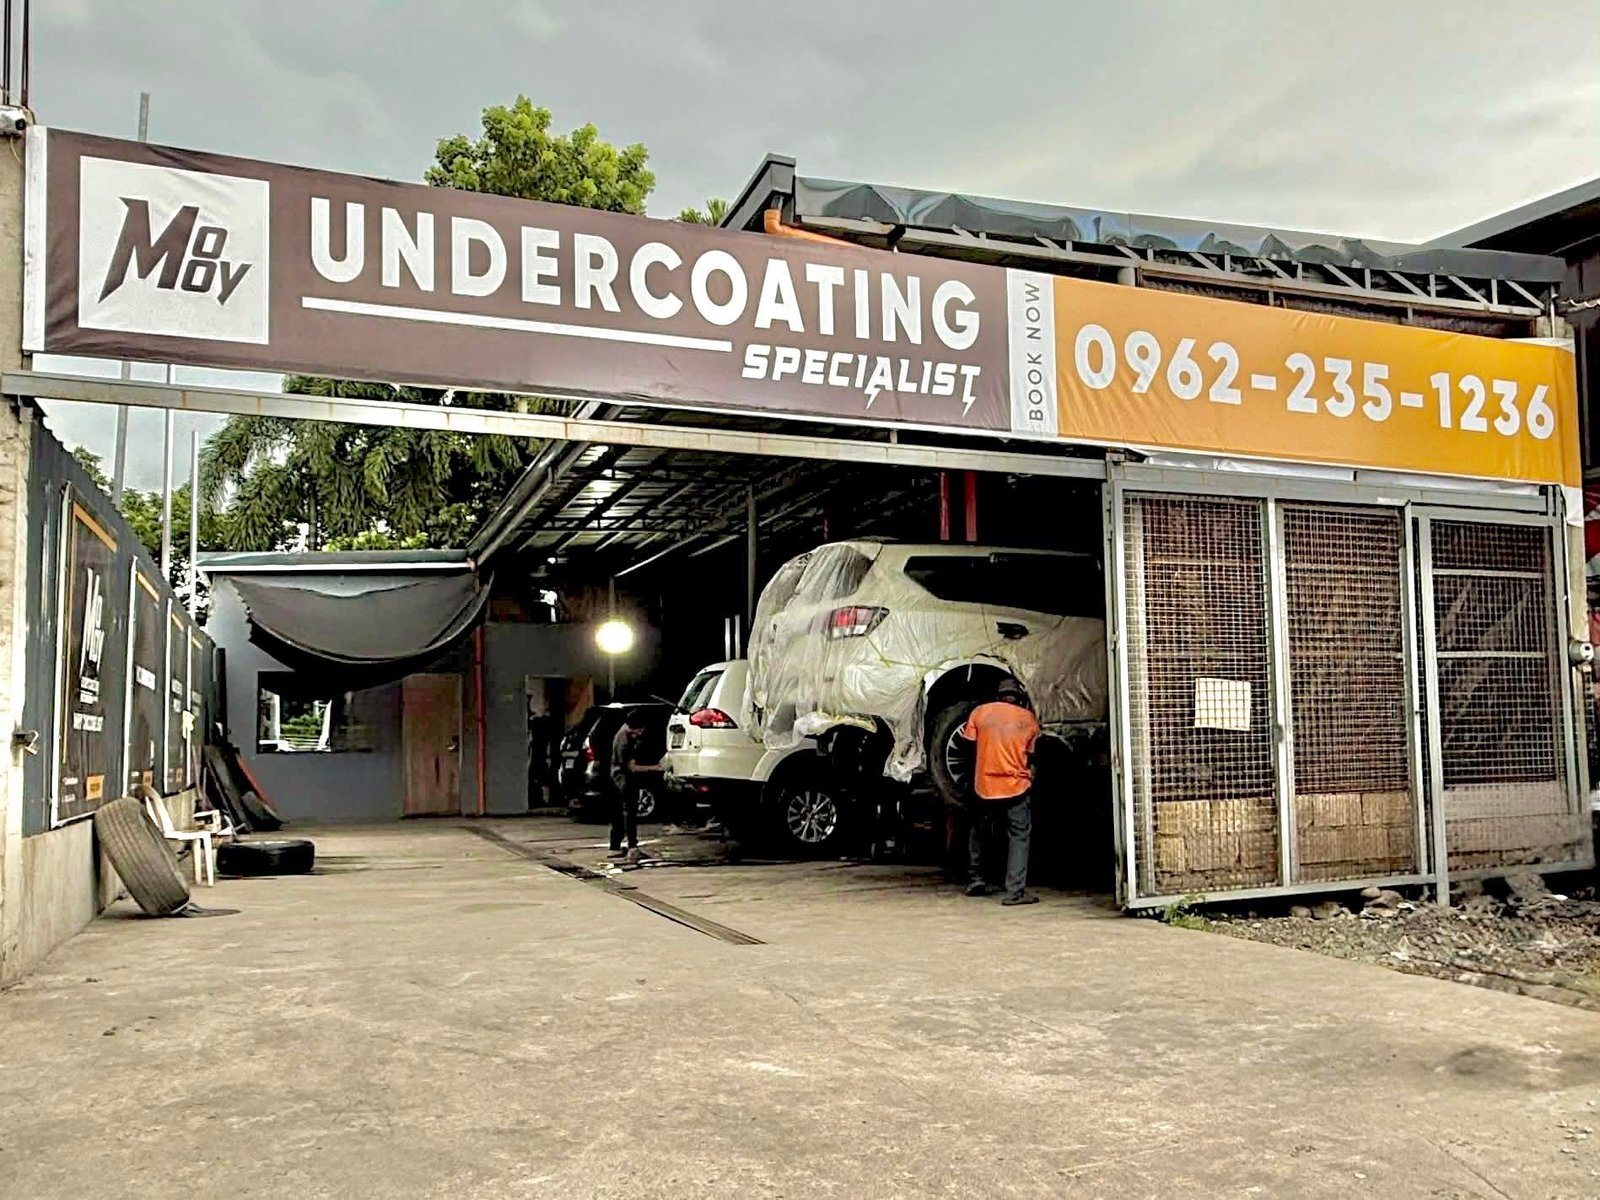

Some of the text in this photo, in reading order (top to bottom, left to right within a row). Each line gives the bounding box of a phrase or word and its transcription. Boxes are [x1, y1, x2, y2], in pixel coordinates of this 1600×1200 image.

[311, 197, 980, 351] UNDERCOATING
[741, 343, 982, 419] SPECIALIST
[1025, 282, 1044, 421] BOOK NOW
[1074, 323, 1555, 440] 0962-235-1236
